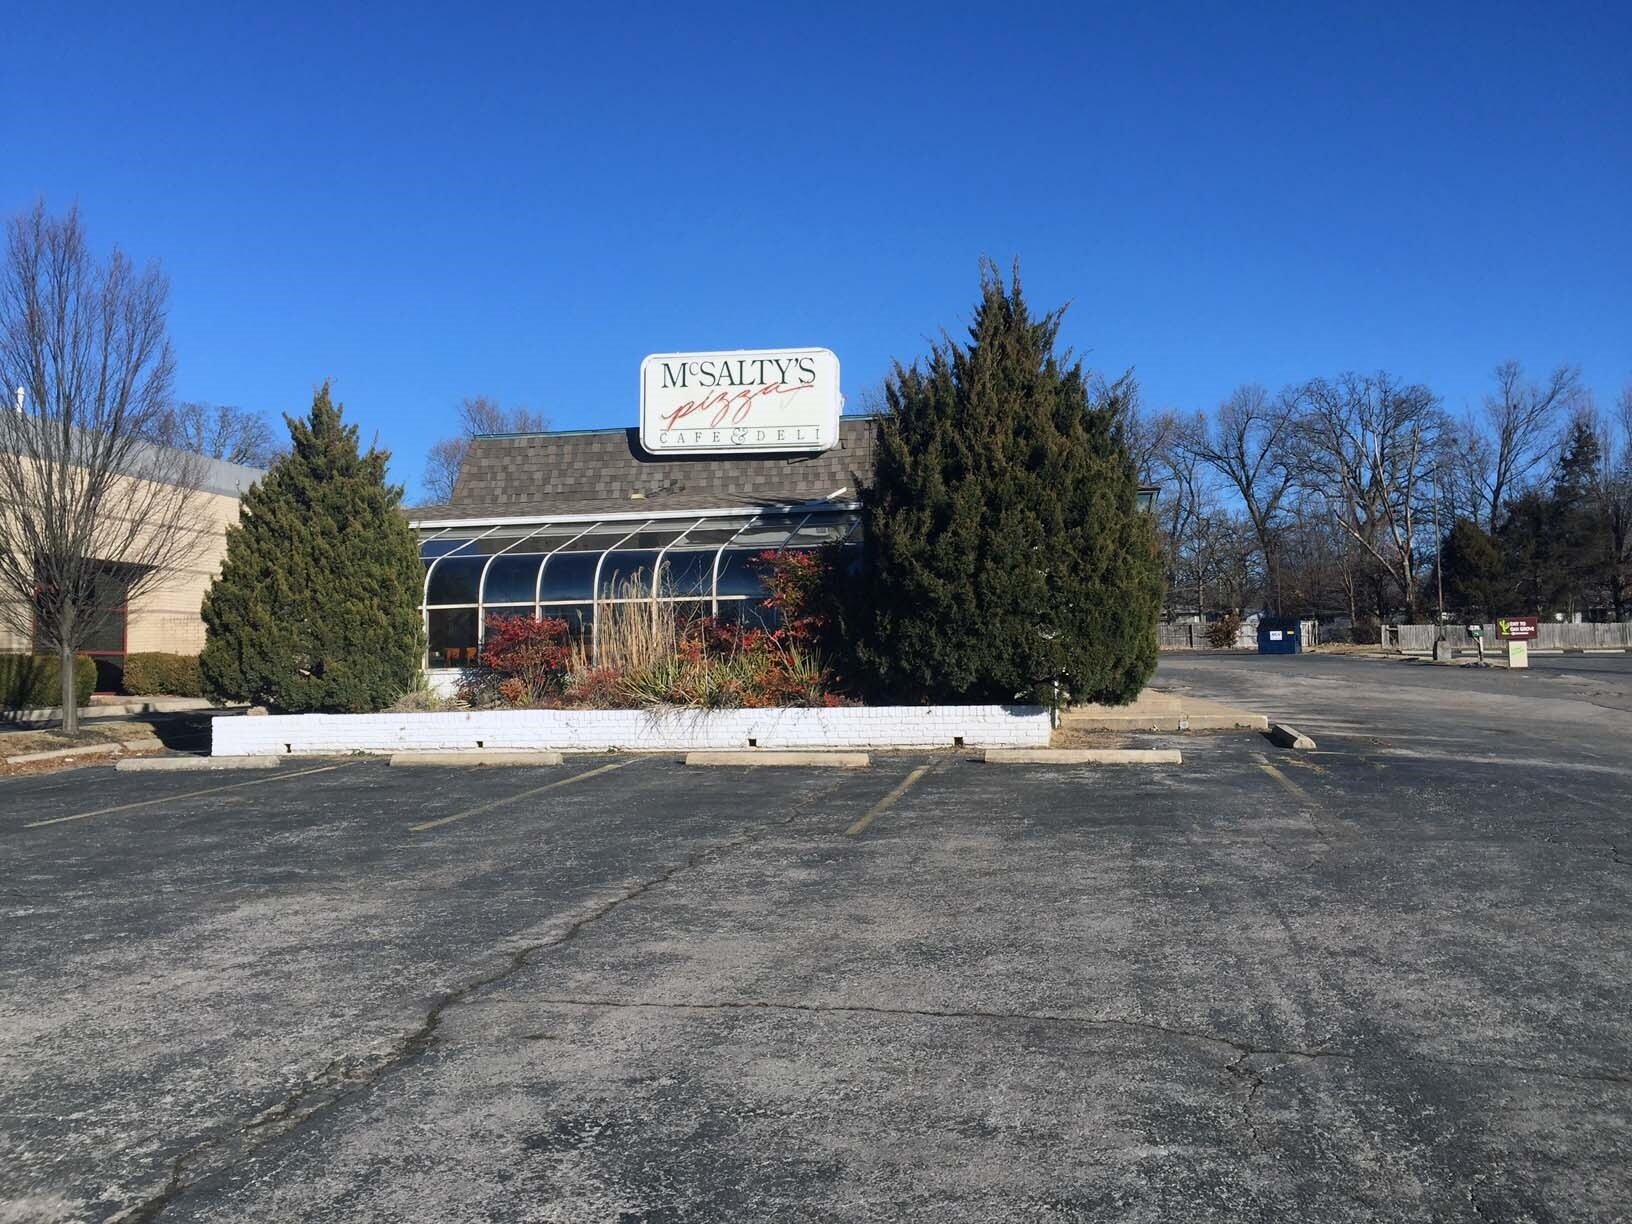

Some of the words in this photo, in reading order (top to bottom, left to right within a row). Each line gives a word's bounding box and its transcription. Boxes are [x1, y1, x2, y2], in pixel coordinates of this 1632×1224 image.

[661, 381, 814, 431] pizza
[659, 431, 721, 444] CAFE
[730, 427, 749, 445] &
[757, 428, 820, 441] DELI
